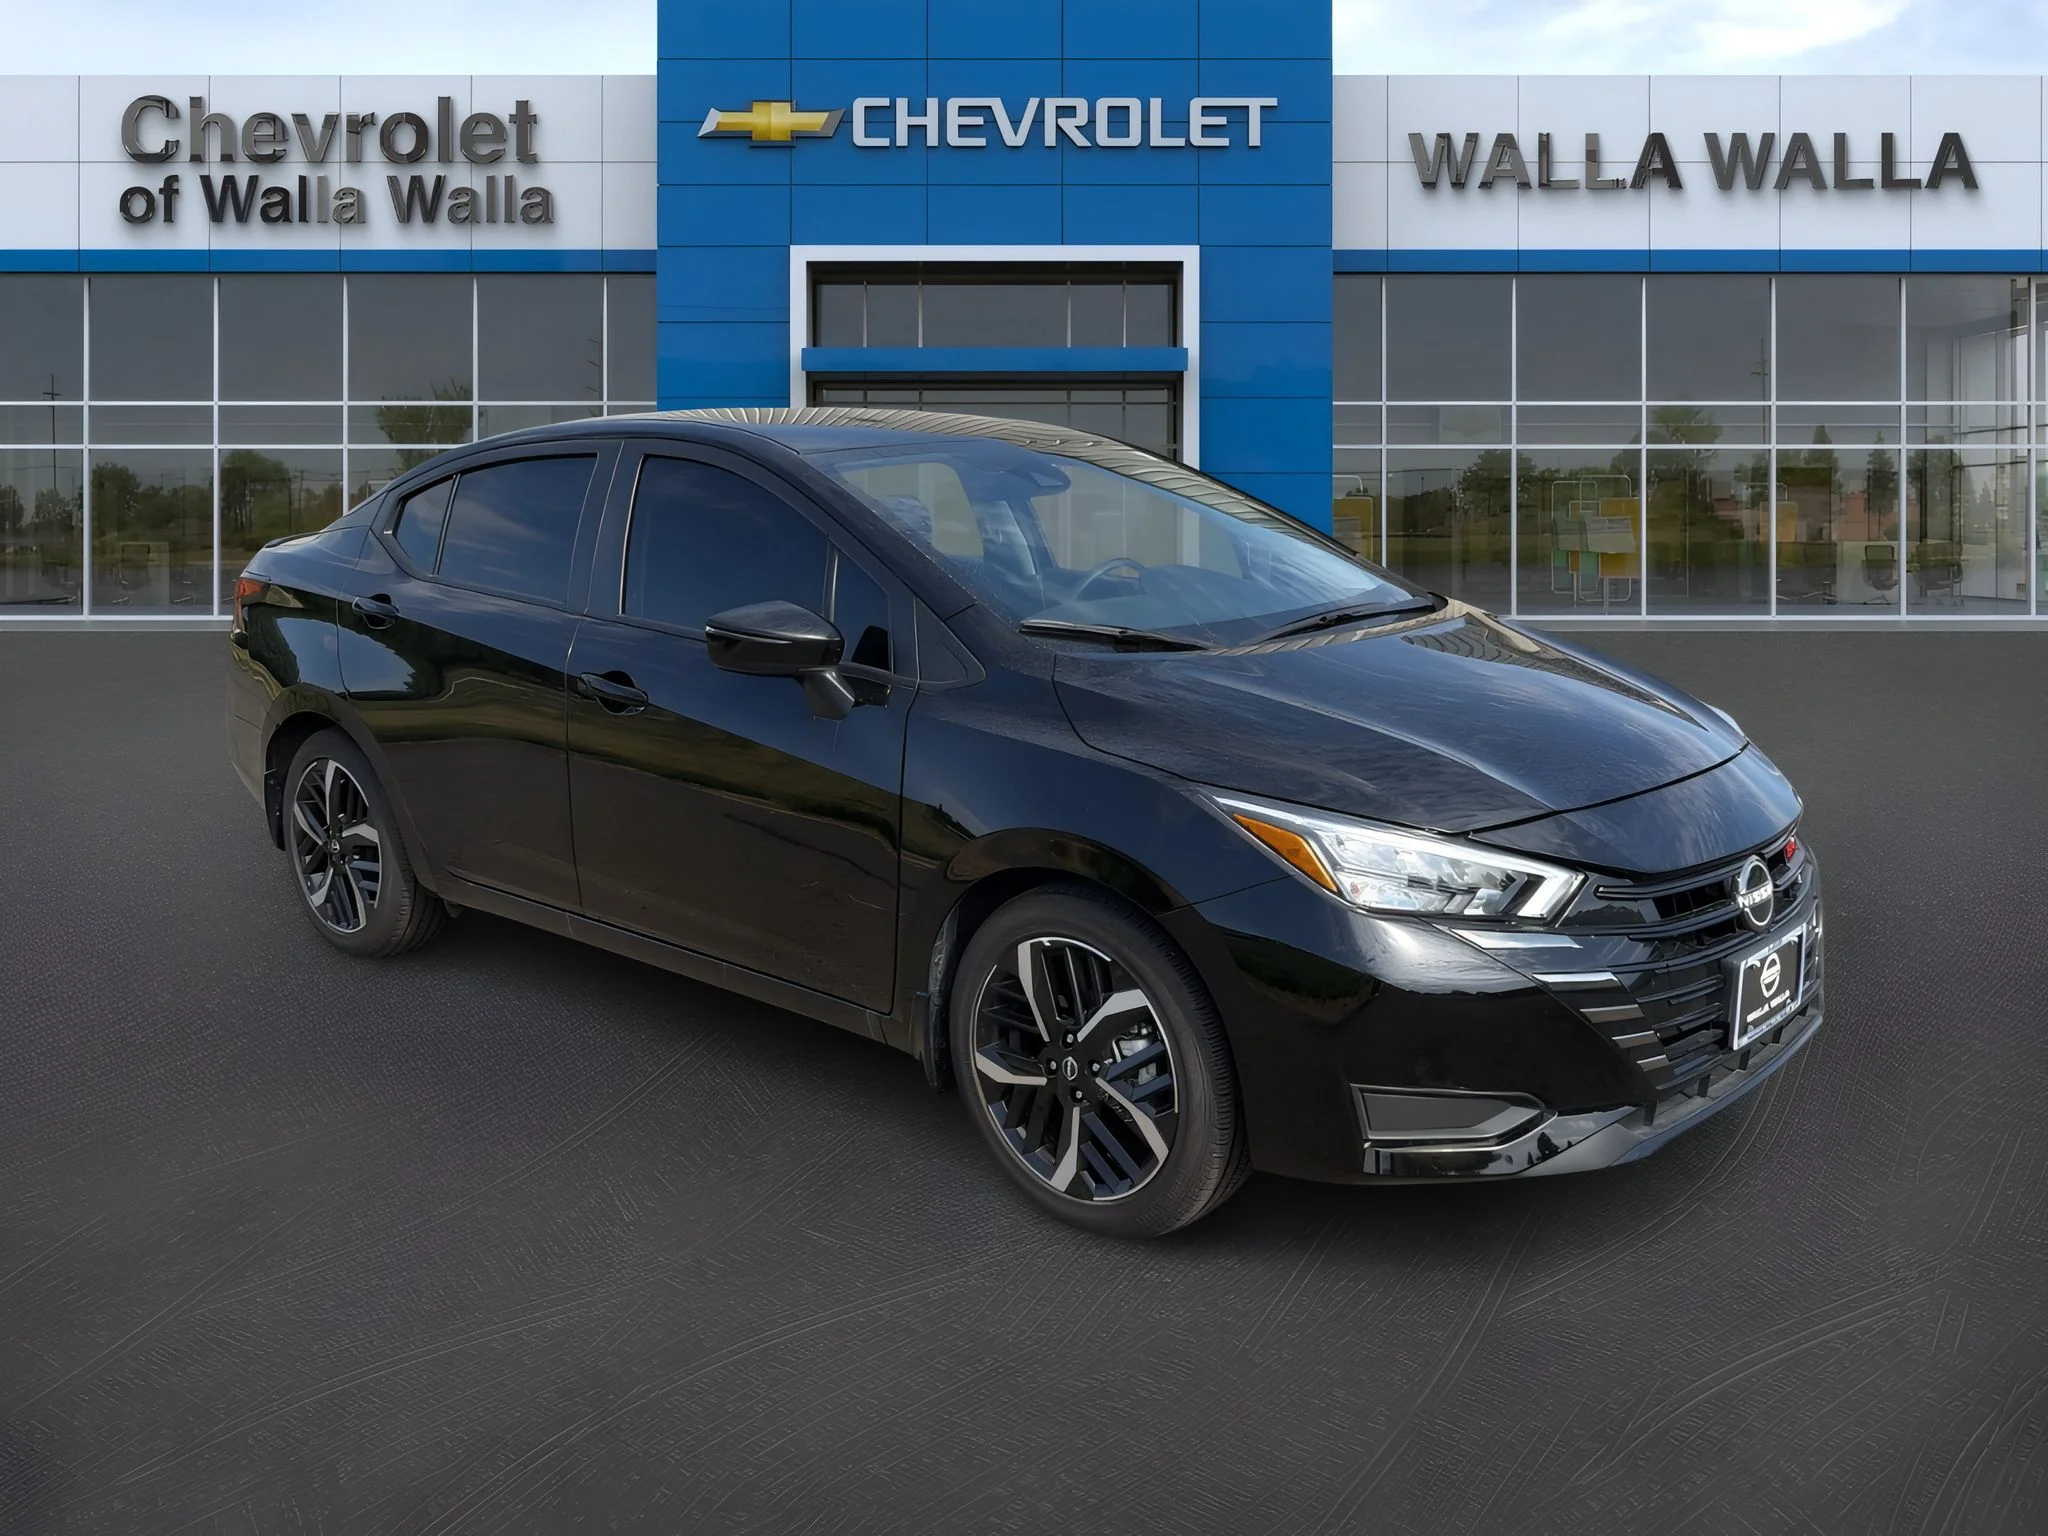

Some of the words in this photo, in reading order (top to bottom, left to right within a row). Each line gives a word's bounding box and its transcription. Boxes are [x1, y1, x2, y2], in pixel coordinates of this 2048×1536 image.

[120, 95, 539, 164] Chevrolet
[852, 97, 1278, 148] CHEVROLET
[1408, 132, 1683, 190] WALLA
[1704, 132, 1979, 190] WALLA
[119, 175, 179, 224] of
[200, 175, 365, 224] Walla
[386, 175, 554, 224] Walla
[1737, 883, 1773, 908] NISS
